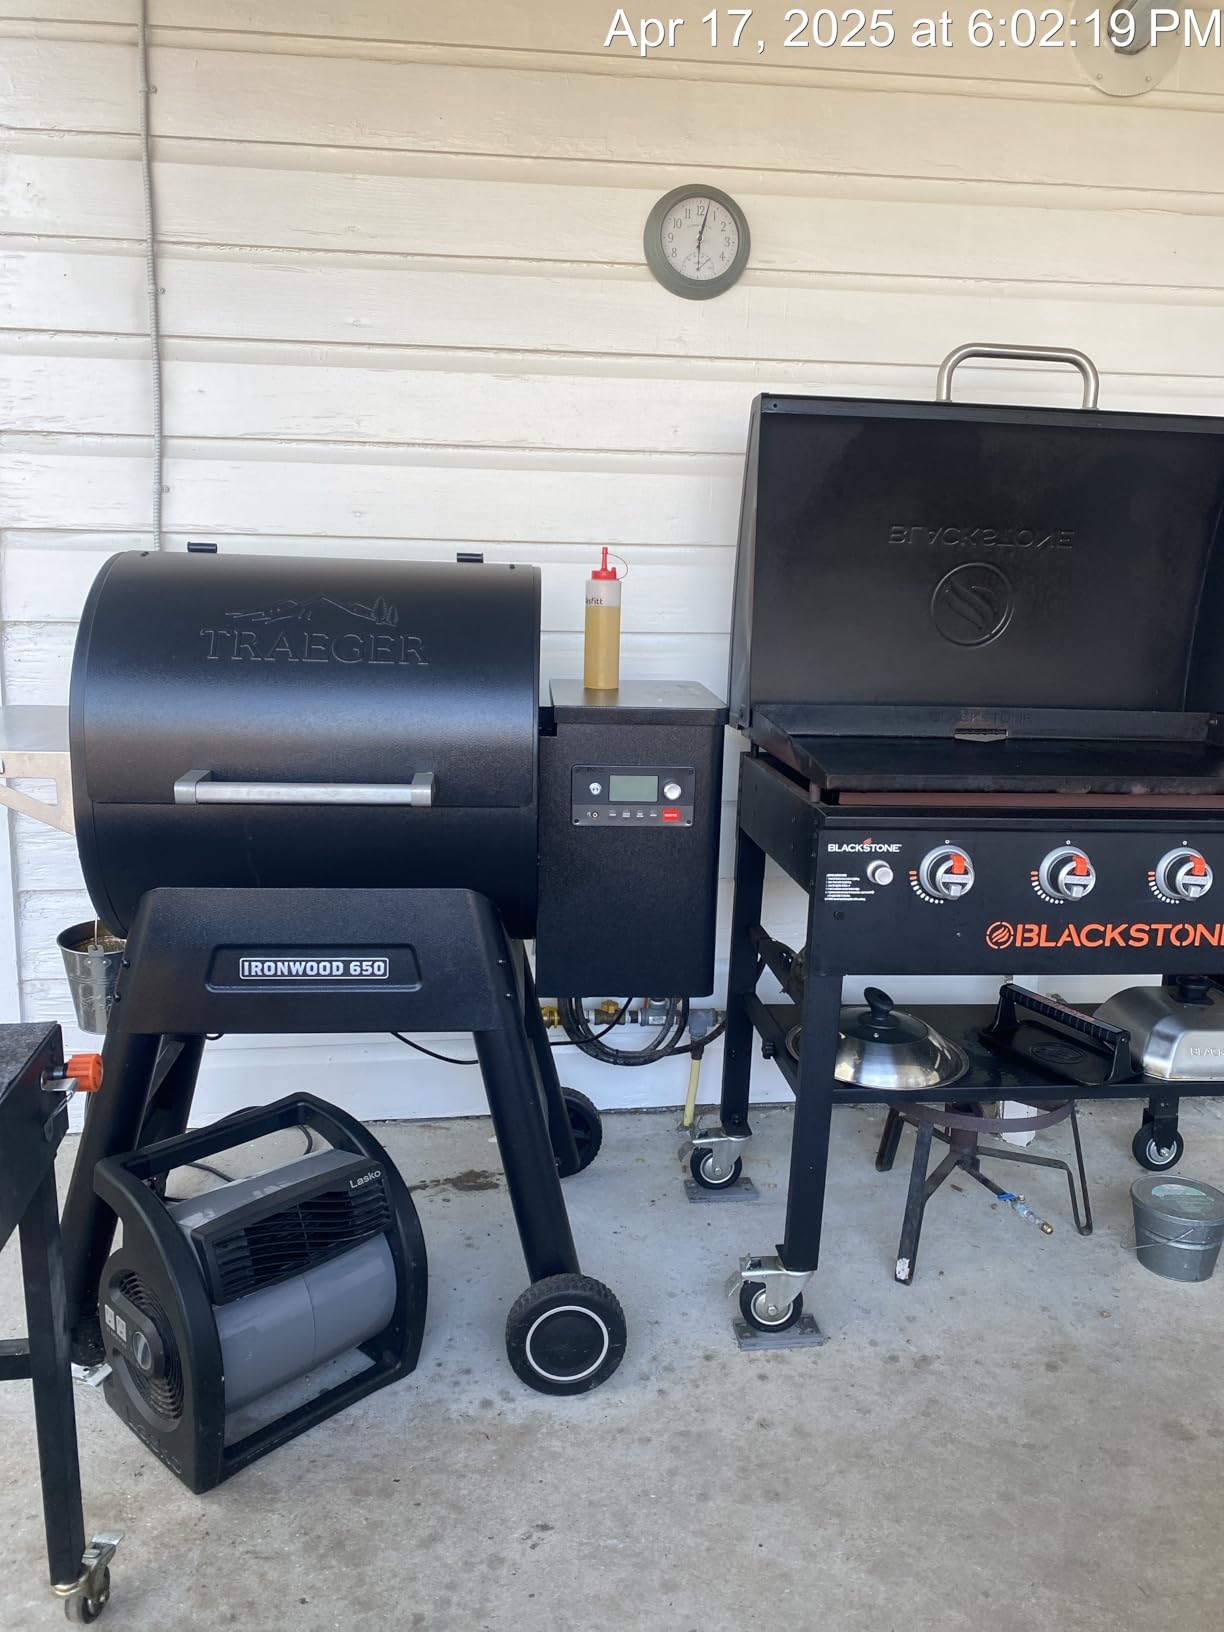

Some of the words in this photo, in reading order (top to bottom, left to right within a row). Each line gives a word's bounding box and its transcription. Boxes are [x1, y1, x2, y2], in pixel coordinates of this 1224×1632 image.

[696, 205, 705, 216] 12
[673, 218, 682, 229] 10
[200, 630, 429, 665] TRAEGER
[827, 843, 901, 853] BLACKSTONE
[1015, 923, 1224, 947] BLACKSTON
[243, 961, 344, 976] IRONWOOD
[350, 961, 385, 976] 650
[349, 1170, 382, 1189] Lasko
